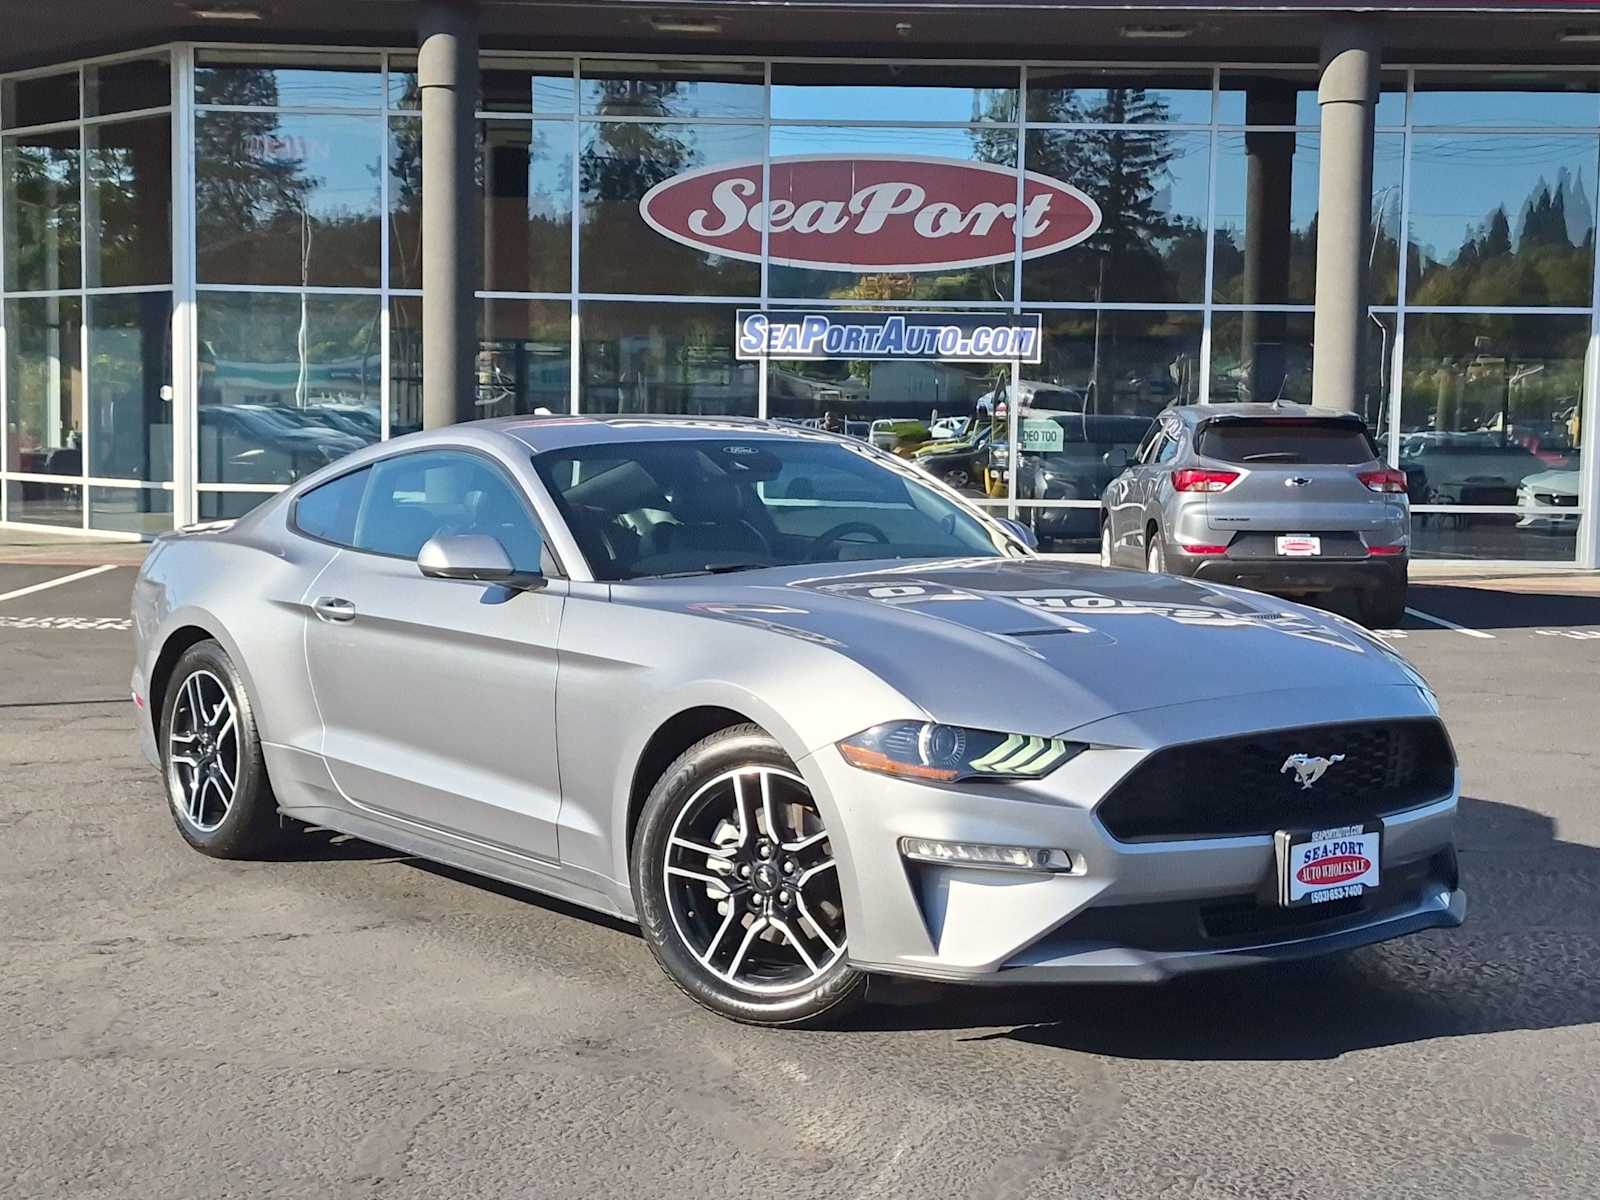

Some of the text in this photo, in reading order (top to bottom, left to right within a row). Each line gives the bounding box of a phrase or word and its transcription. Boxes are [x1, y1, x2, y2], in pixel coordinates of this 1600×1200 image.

[688, 178, 1053, 238] SeaPort
[1302, 860, 1366, 881] AUTO WHOLESALE
